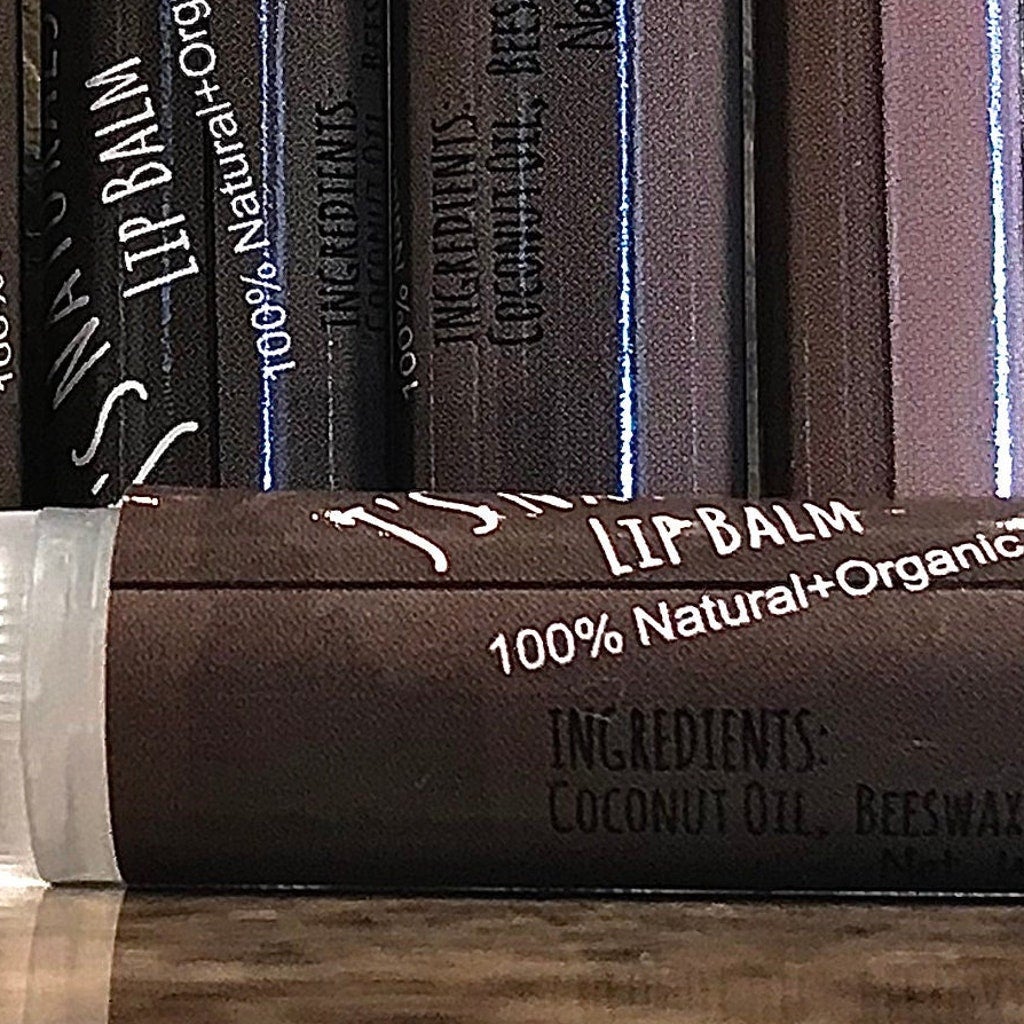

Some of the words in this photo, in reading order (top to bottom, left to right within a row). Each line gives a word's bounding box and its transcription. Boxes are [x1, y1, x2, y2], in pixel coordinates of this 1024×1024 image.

[85, 56, 173, 205] BALM
[119, 213, 200, 299] LIP
[315, 88, 357, 330] INGREDIENTS:
[430, 102, 480, 346] INGREDIENTS:
[486, 188, 543, 347] COCONUT
[240, 260, 296, 380] 100%
[489, 612, 624, 675] 100%
[633, 533, 1024, 646] Natural+Organic
[589, 515, 690, 576] LIP
[695, 501, 865, 556] BALM
[547, 705, 829, 774] INGREDIENTS:
[548, 779, 727, 835] COCONUT
